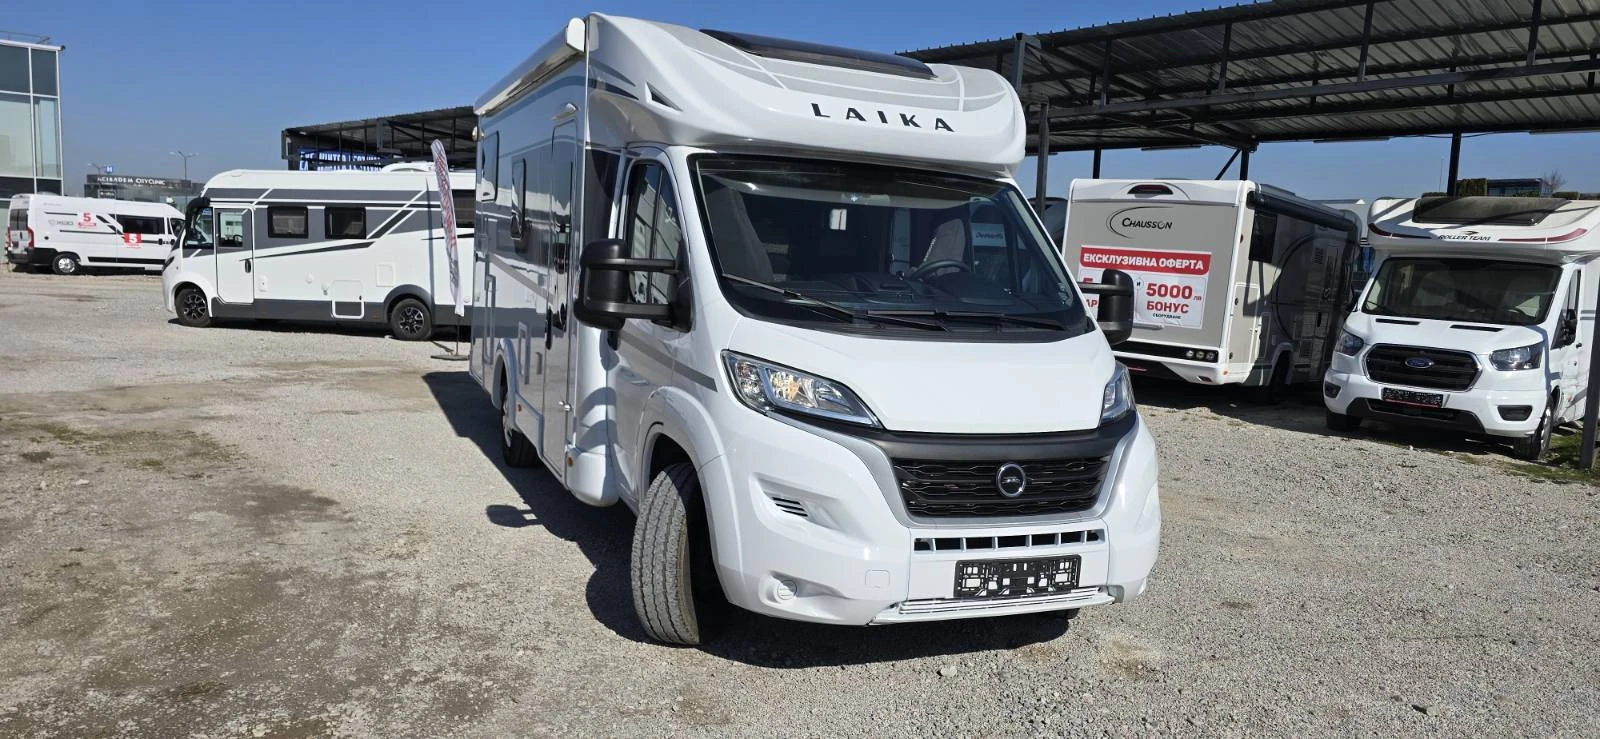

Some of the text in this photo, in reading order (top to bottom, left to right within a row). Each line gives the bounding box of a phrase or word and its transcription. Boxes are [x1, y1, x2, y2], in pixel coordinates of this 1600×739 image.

[811, 102, 955, 132] LAIKA
[83, 213, 92, 222] 5
[1121, 218, 1173, 230] CHAUSSON
[1083, 253, 1204, 270] ЕКСКЛУЗИВНА ОФЕРТА
[1146, 283, 1193, 299] 5000
[1146, 301, 1190, 314] БОНУС
